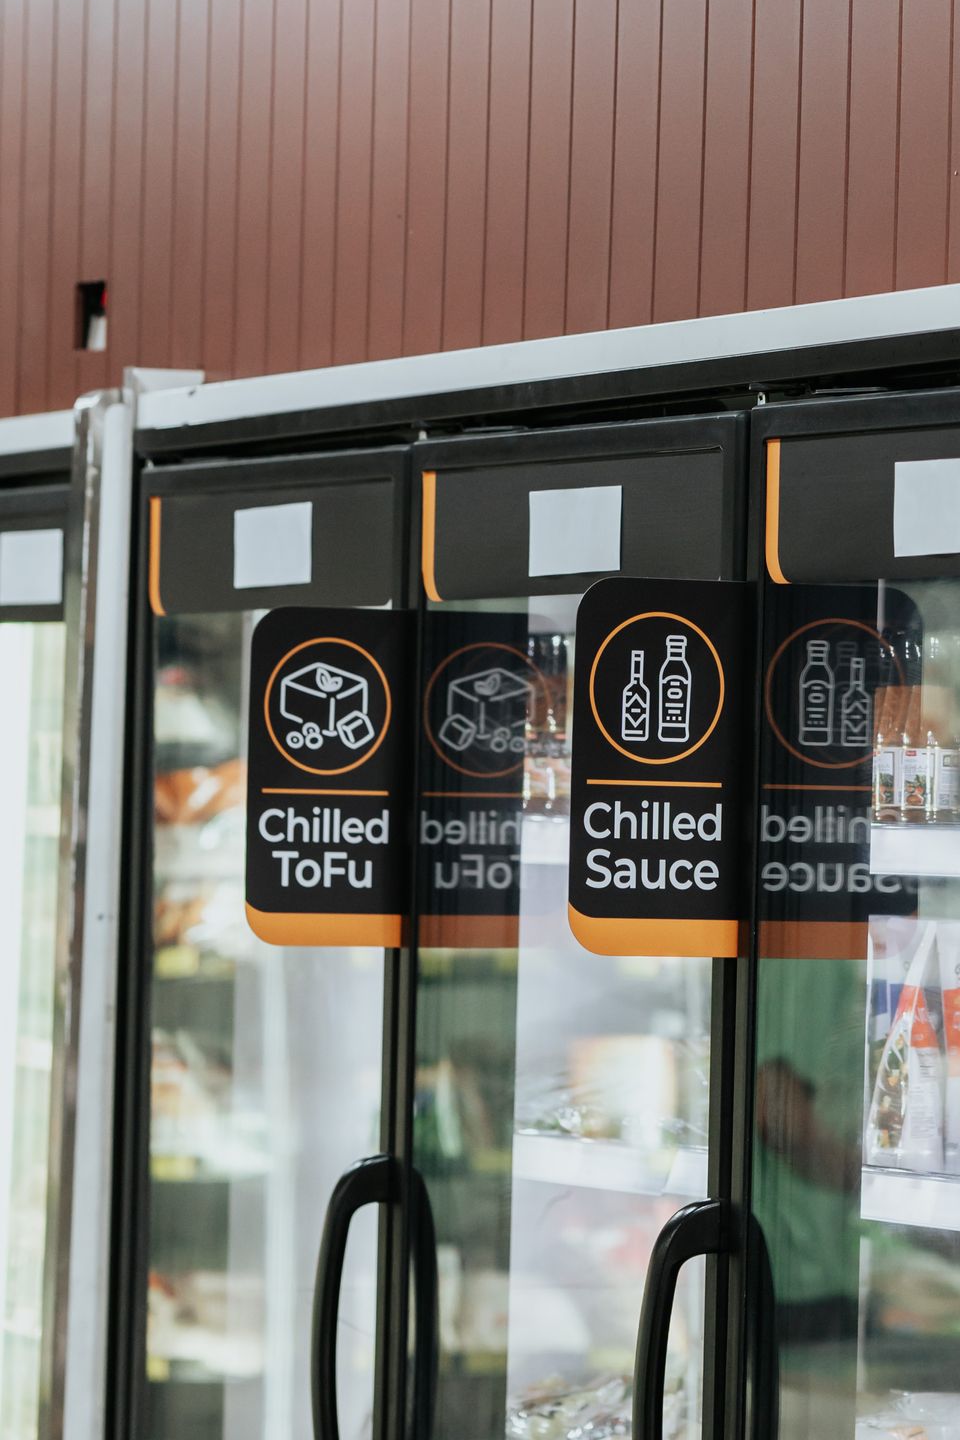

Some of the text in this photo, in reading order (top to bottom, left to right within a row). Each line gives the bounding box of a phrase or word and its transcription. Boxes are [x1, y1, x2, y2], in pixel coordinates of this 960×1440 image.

[258, 806, 390, 846] Chilled
[583, 801, 723, 844] Chilled
[271, 851, 373, 890] ToFu
[585, 849, 721, 891] Sauce
